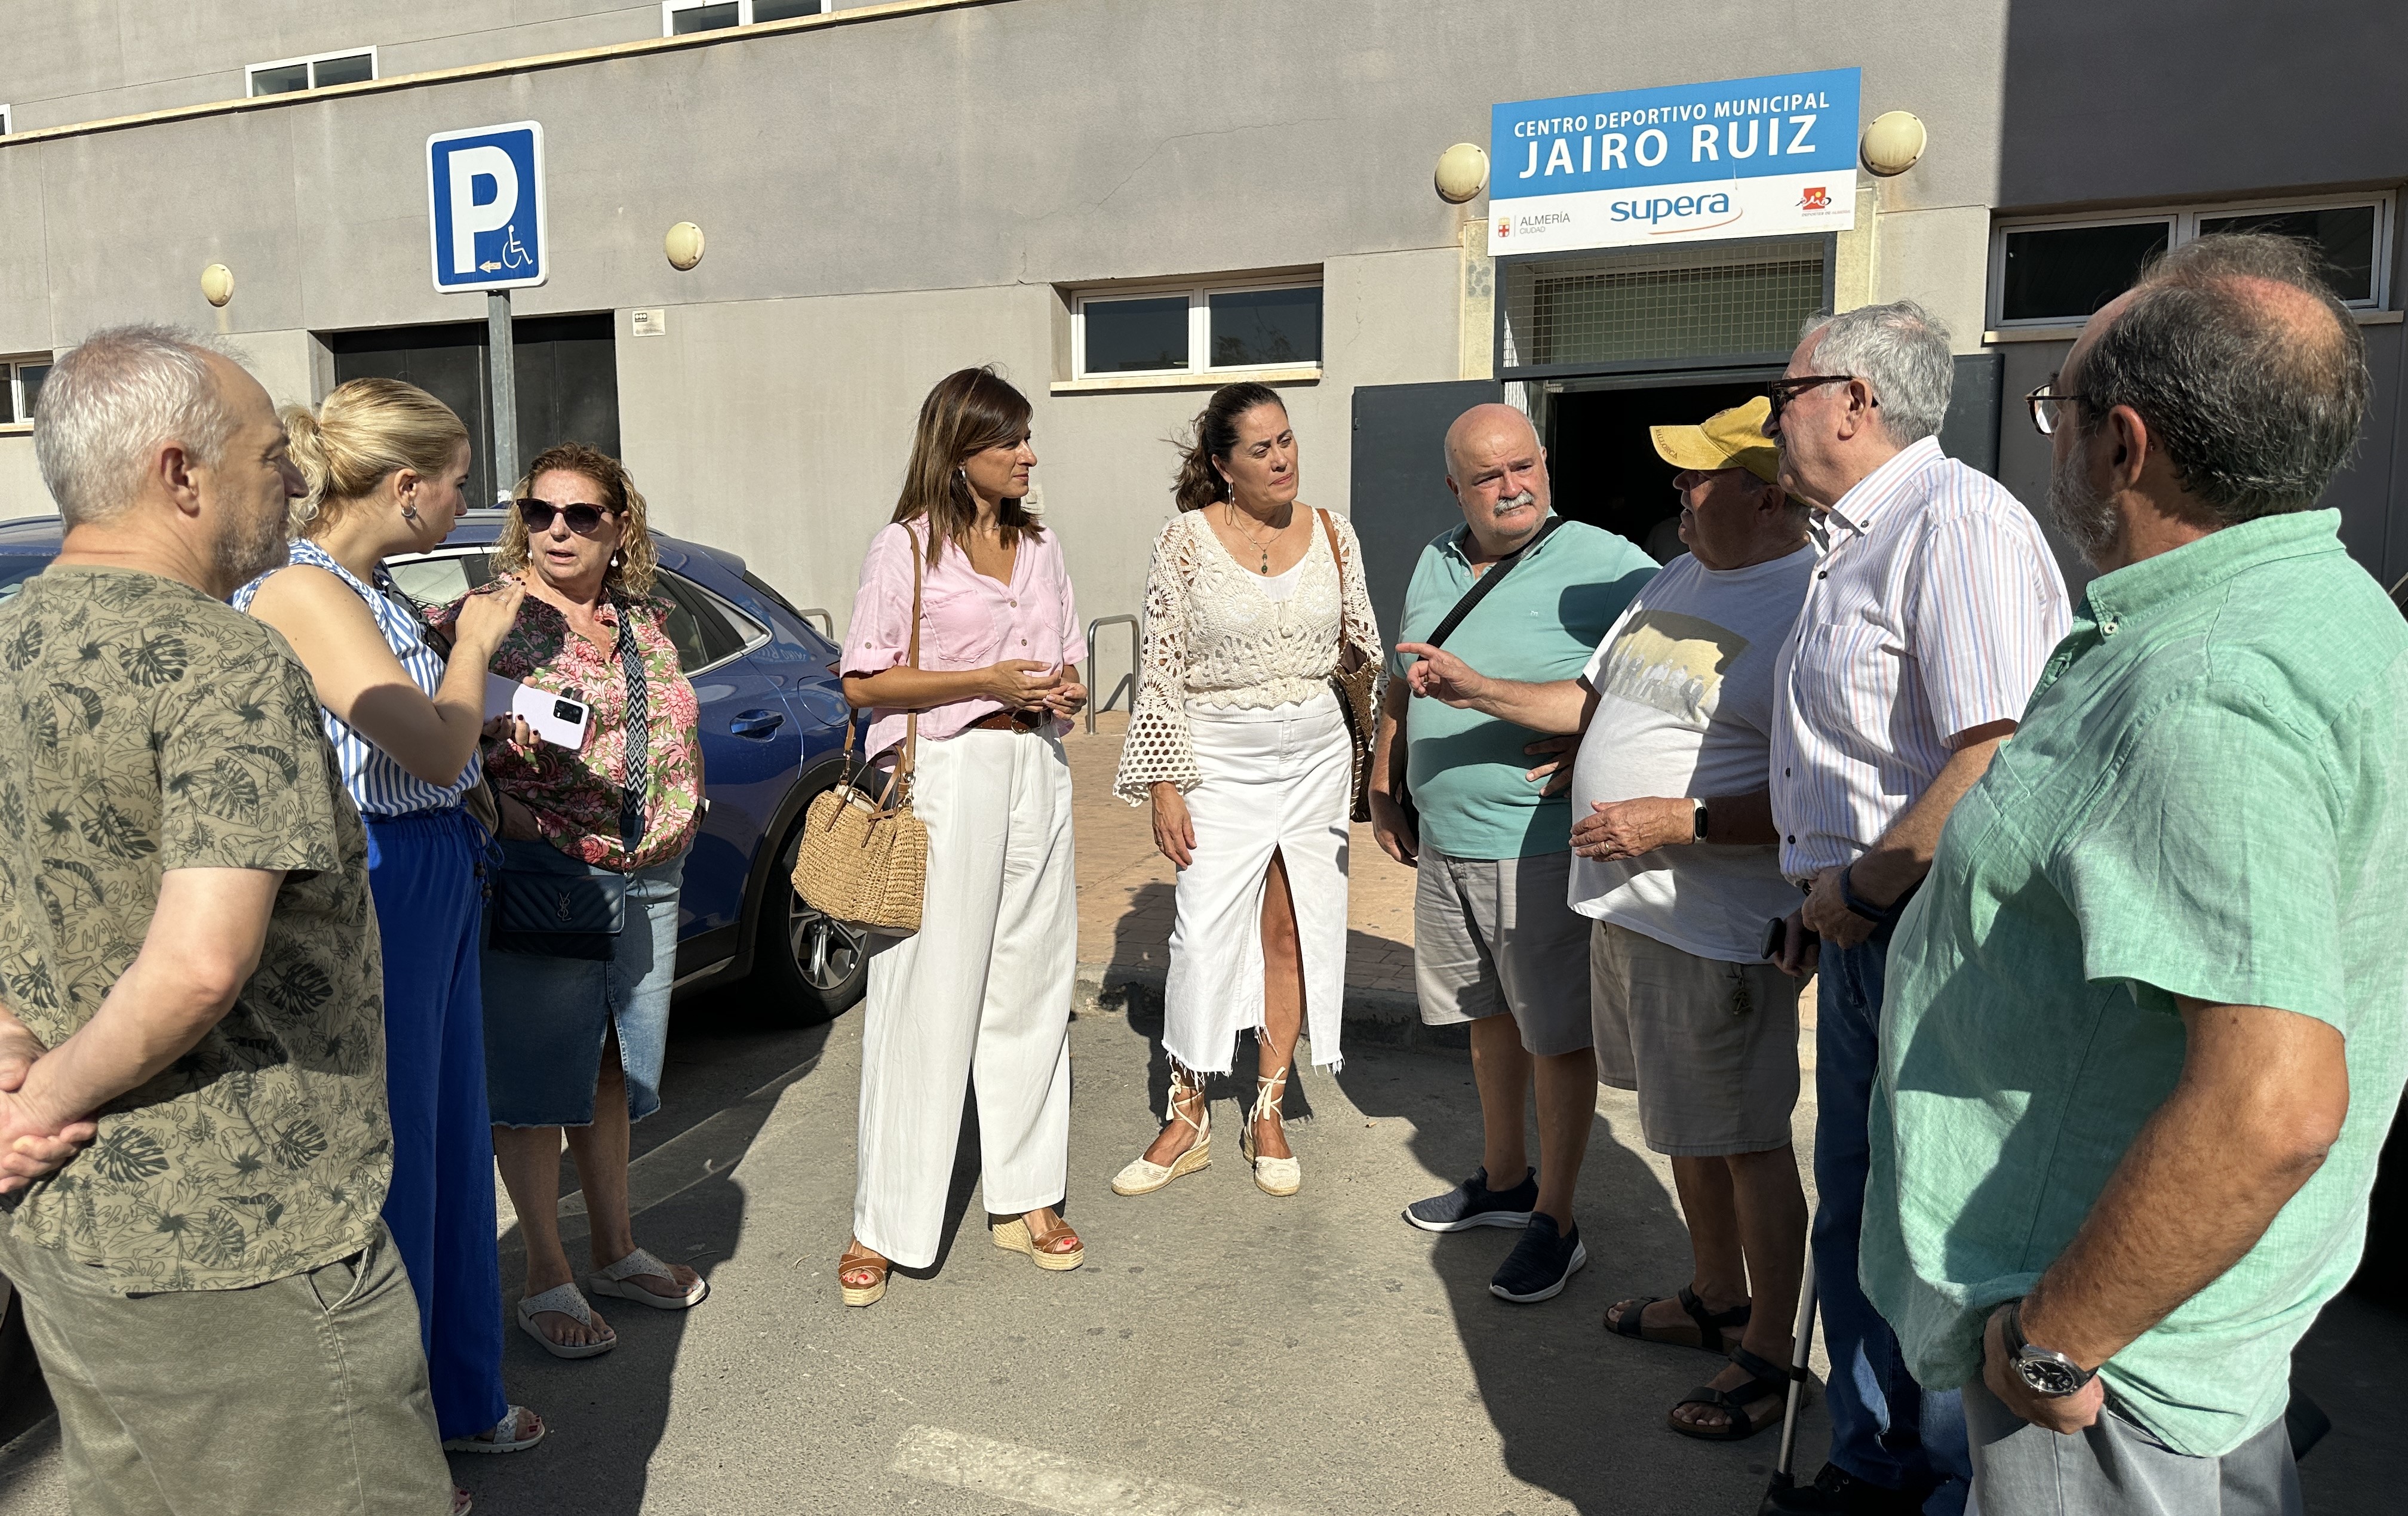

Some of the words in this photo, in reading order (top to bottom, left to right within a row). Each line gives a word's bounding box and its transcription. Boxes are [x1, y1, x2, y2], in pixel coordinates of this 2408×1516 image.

[1514, 115, 1588, 138] CENTRO
[1595, 103, 1707, 130] DEPORTIVO
[1714, 91, 1830, 118] MUNICIPAL
[1519, 128, 1668, 179] JAIRO
[1691, 114, 1817, 162] RUIZ
[448, 146, 518, 274] P
[1520, 211, 1571, 227] ALMERÍA
[1610, 193, 1730, 225] supera
[1519, 226, 1546, 235] CIUDAD
[1655, 429, 1678, 459] MALLORCA
